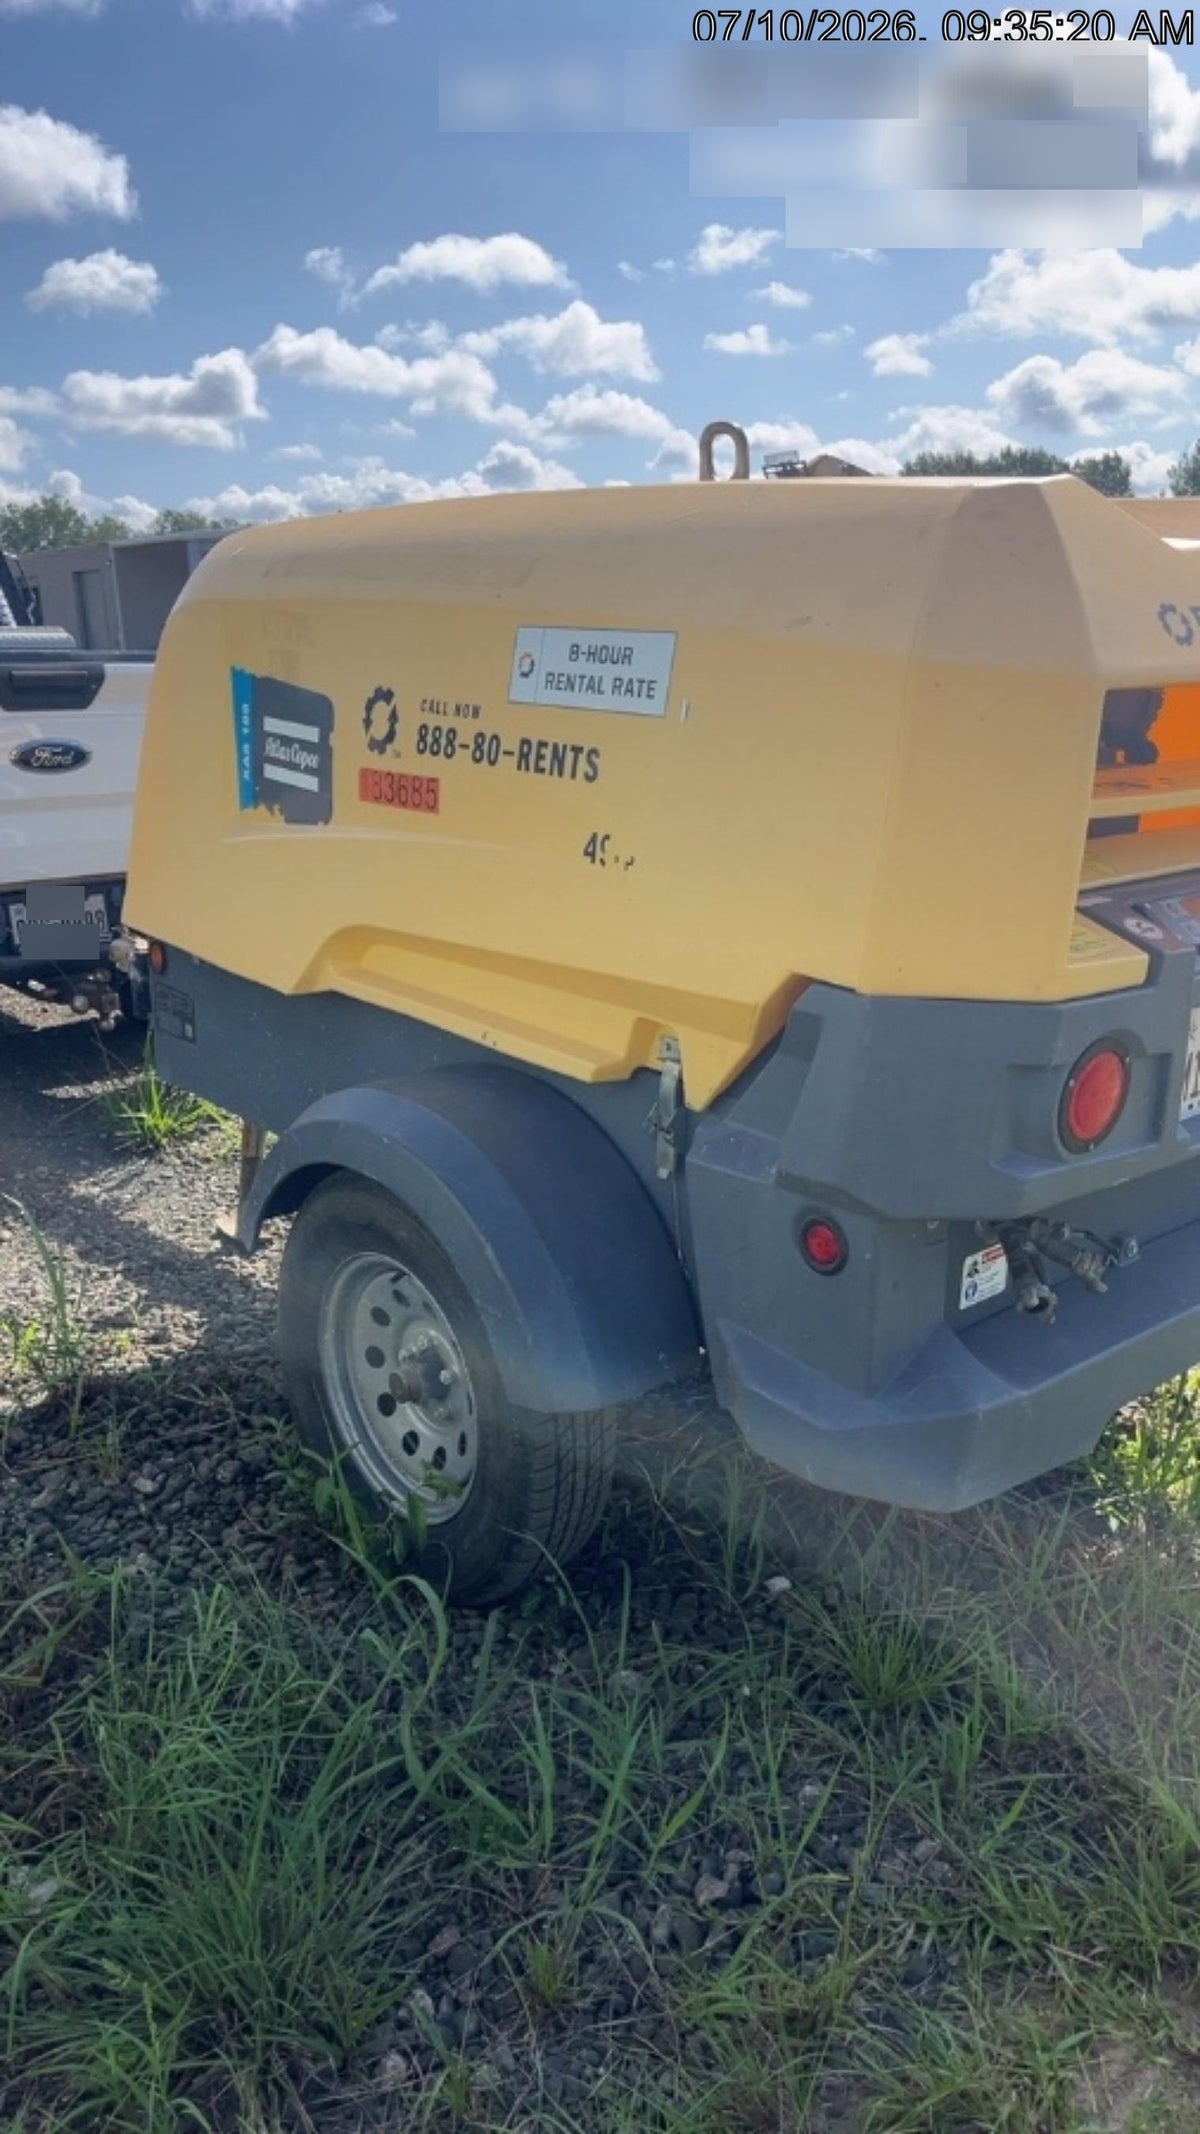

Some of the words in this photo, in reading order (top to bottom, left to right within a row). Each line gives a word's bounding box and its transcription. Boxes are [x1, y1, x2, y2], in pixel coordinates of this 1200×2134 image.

[568, 643, 634, 666] 8-HOUR
[544, 672, 605, 696] RENTAL
[611, 676, 658, 700] RATE
[419, 698, 448, 716] CALL
[453, 701, 482, 719] NOW
[30, 746, 75, 768] Ford
[264, 736, 291, 762] Atlas
[291, 743, 320, 770] Copco
[416, 722, 601, 783] 888-80-RENTS
